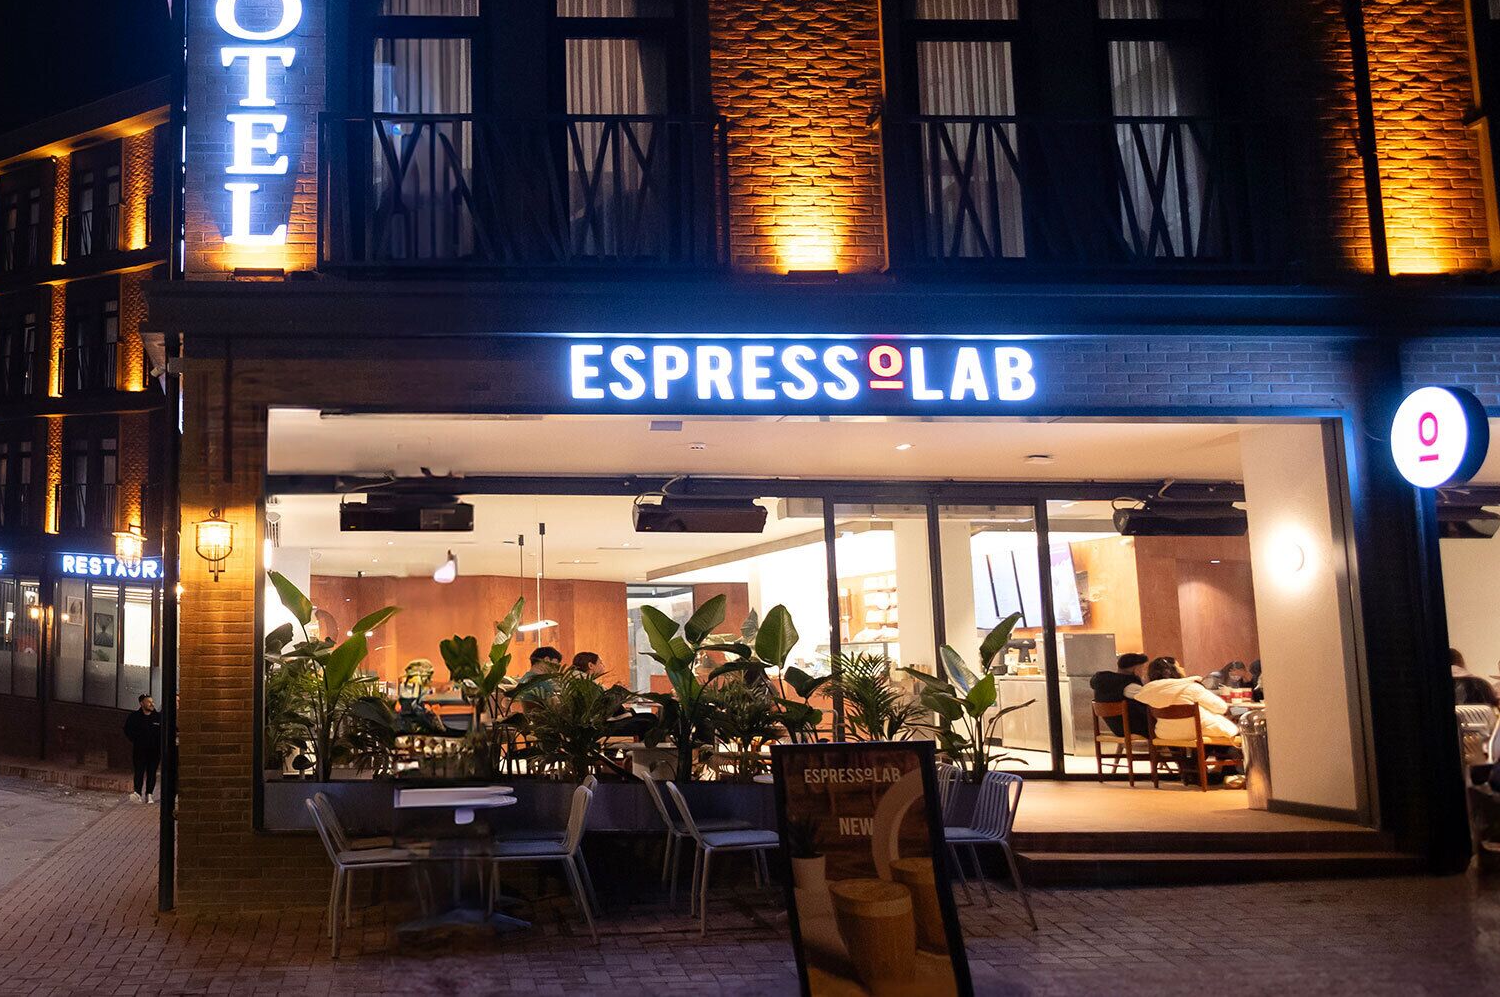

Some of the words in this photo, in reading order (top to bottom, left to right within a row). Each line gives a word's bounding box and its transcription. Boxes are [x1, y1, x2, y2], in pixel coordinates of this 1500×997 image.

[569, 343, 1037, 402] ESPRESSOLAB
[62, 554, 164, 579] RESTAUR
[804, 768, 901, 785] ESPRESSOLAB
[838, 817, 874, 836] NEW
